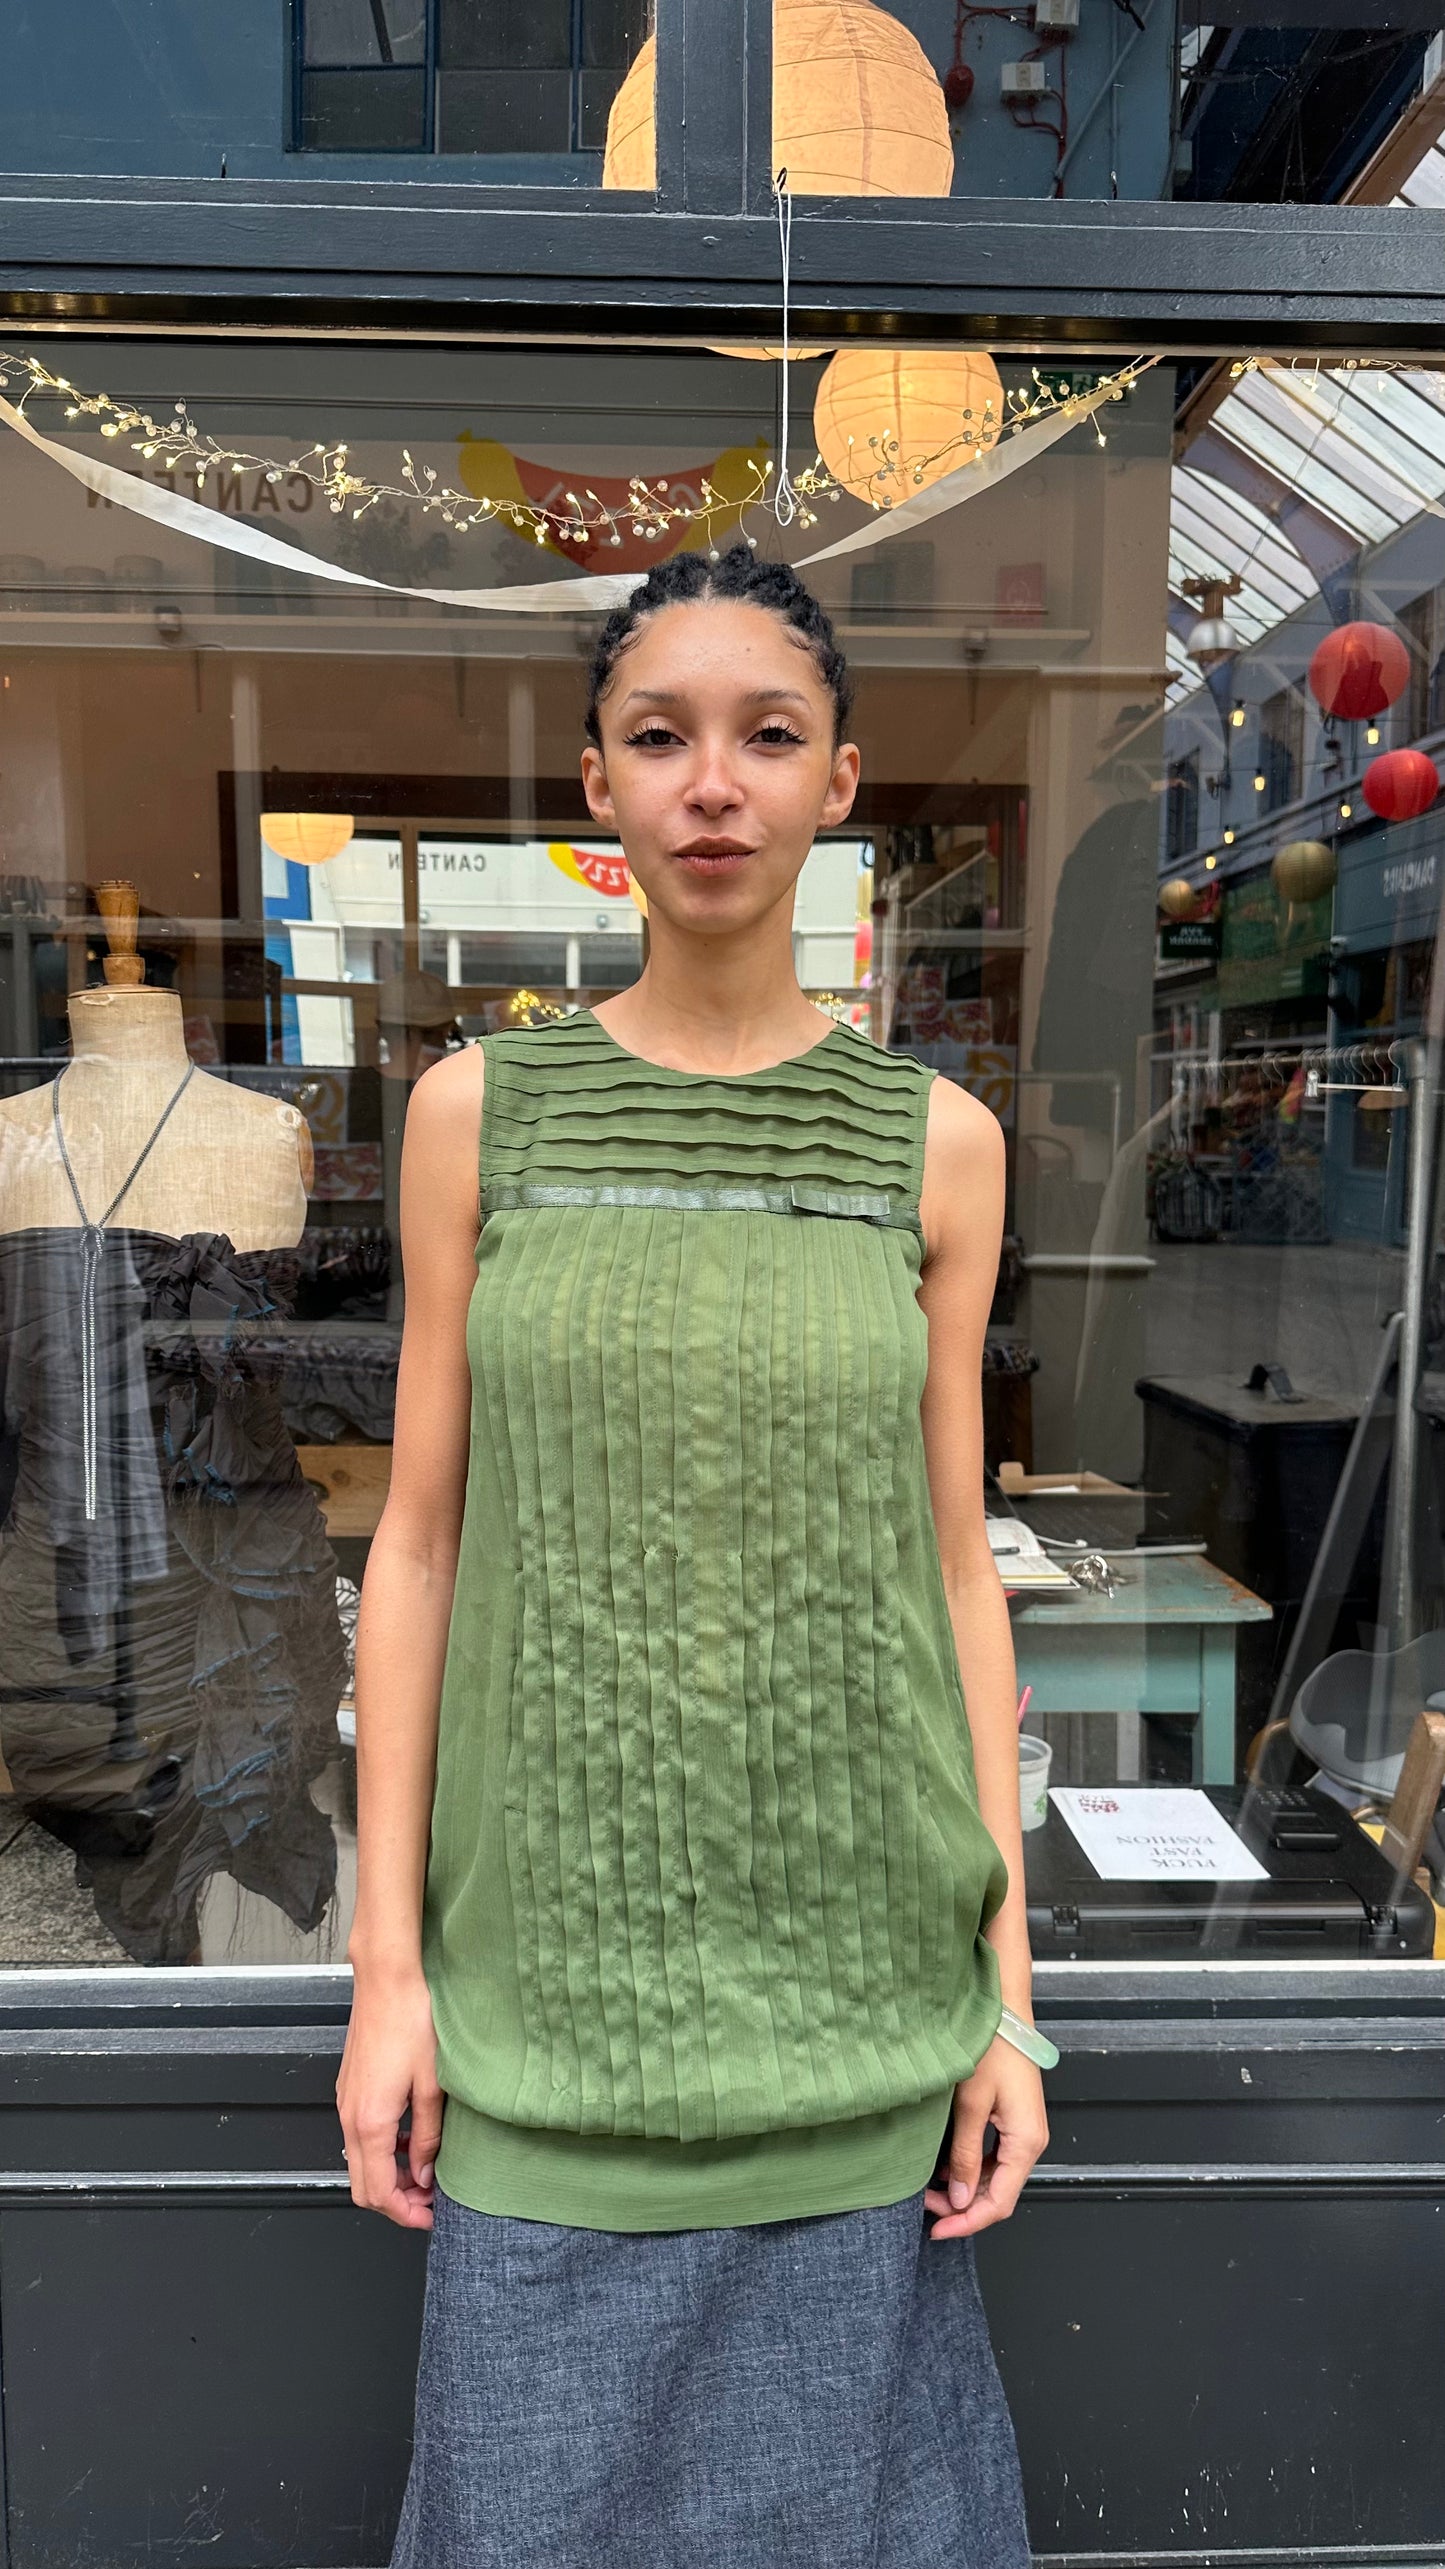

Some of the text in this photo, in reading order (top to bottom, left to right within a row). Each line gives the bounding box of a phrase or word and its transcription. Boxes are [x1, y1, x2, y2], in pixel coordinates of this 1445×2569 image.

[1116, 1836, 1214, 1845] FASHION
[1150, 1847, 1203, 1856] FAST
[1152, 1858, 1216, 1868] FUCK
